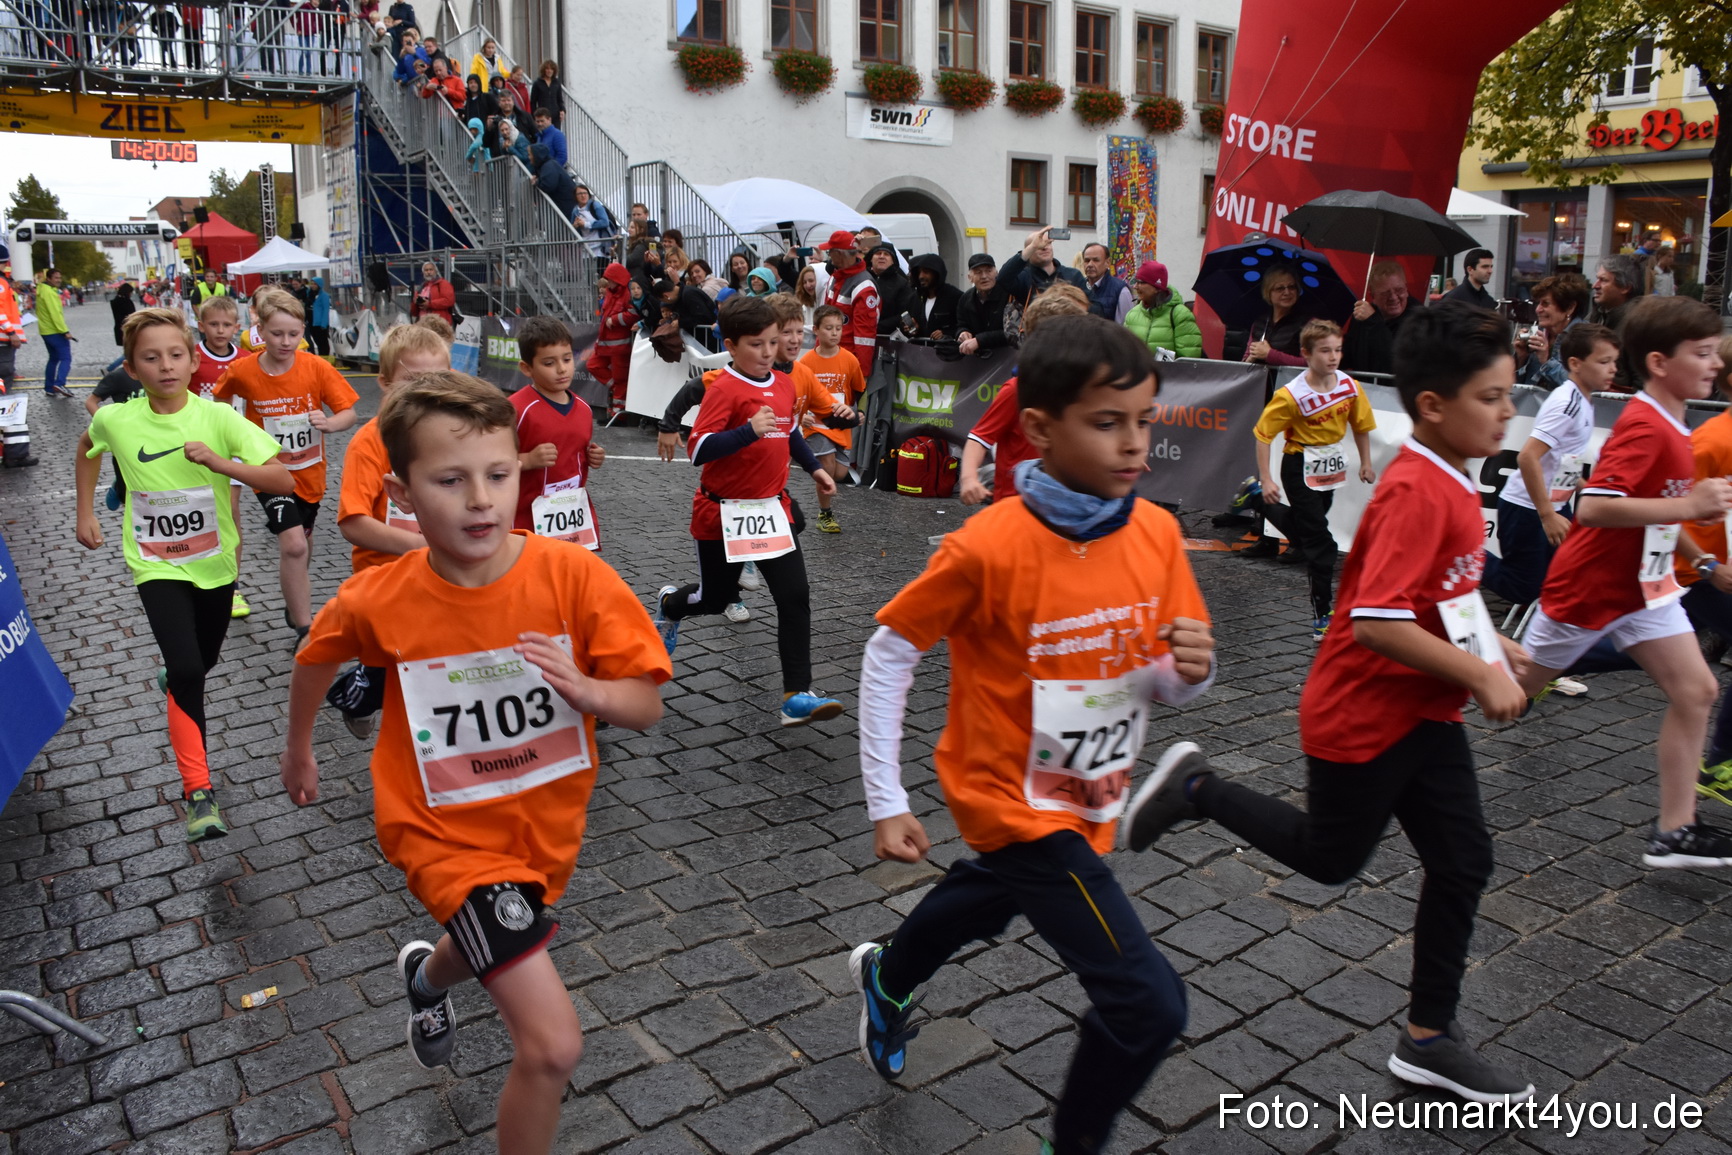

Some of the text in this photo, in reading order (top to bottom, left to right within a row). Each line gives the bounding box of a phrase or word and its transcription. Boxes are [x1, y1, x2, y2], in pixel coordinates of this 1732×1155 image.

[100, 103, 186, 134] ZIEL
[870, 108, 912, 126] swn
[1226, 113, 1317, 162] STORE
[46, 223, 75, 234] MINI
[274, 428, 312, 450] 7161
[1312, 455, 1345, 474] 7196
[143, 510, 205, 538] 7099
[273, 504, 285, 523] 7
[543, 507, 584, 533] 7048
[733, 514, 777, 536] 7021
[166, 543, 190, 554] Attila
[465, 660, 523, 681] BOCK
[432, 686, 555, 747] 7103
[470, 748, 539, 775] Dominik
